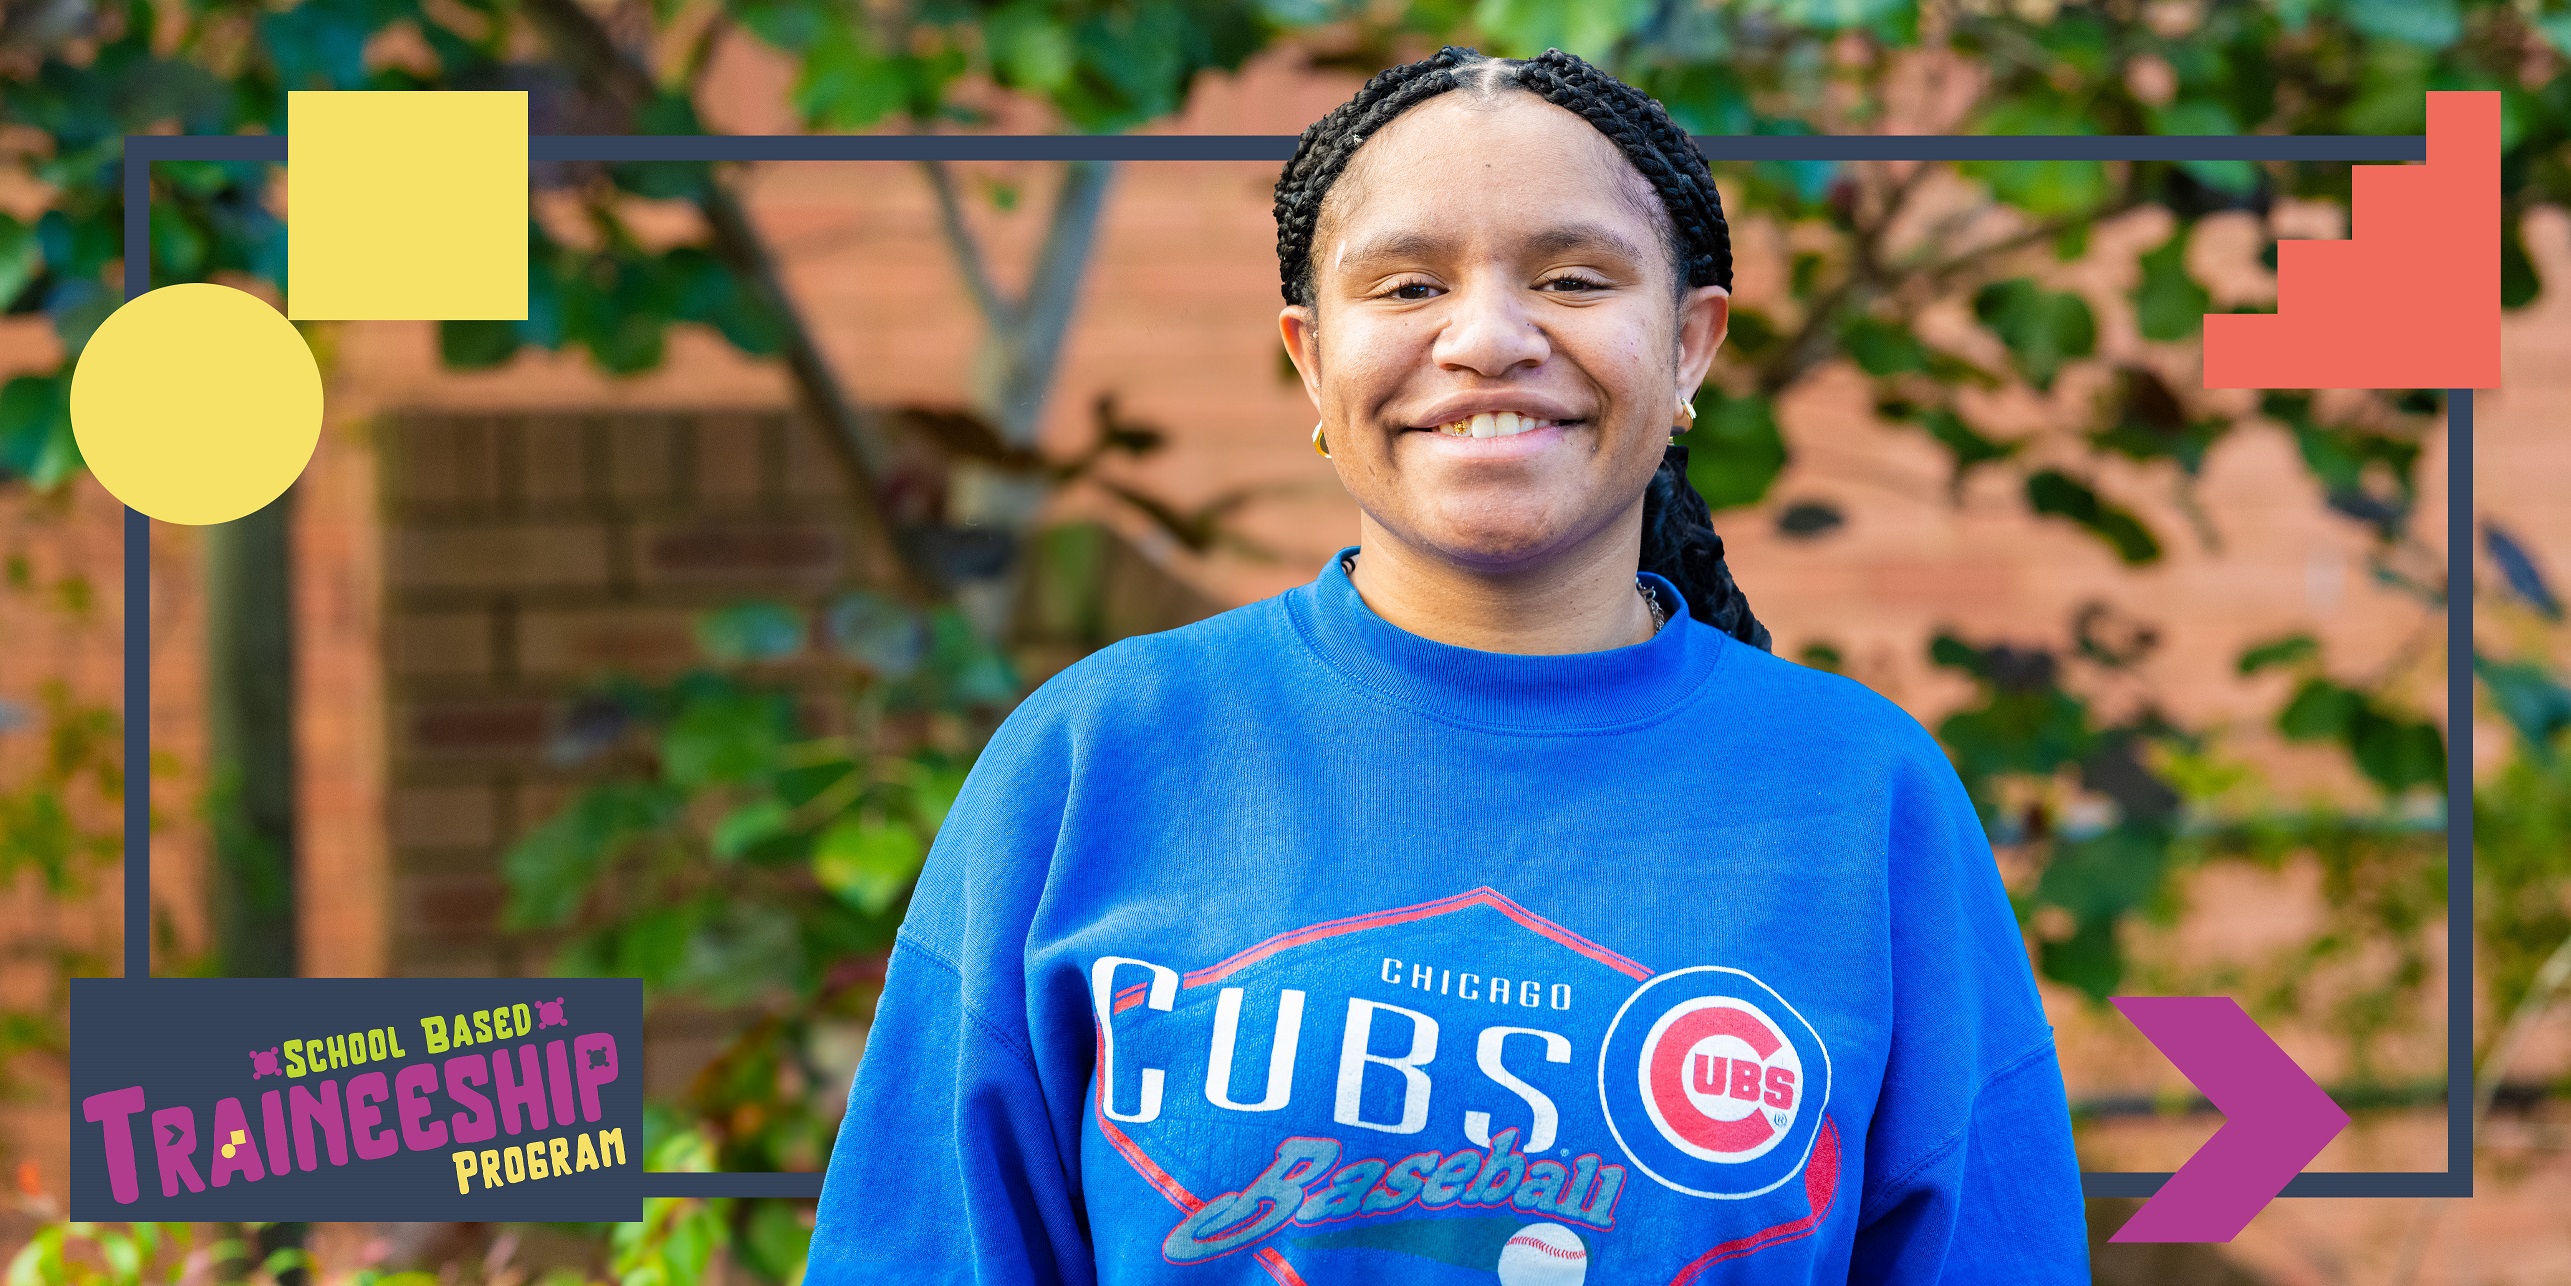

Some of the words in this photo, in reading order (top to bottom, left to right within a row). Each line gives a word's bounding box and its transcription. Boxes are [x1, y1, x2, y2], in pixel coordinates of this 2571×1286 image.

[1091, 955, 1573, 1155] CUBS
[1381, 957, 1572, 1012] CHICAGO
[1649, 1006, 1796, 1154] CUBS
[1162, 1127, 1628, 1266] Baseball
